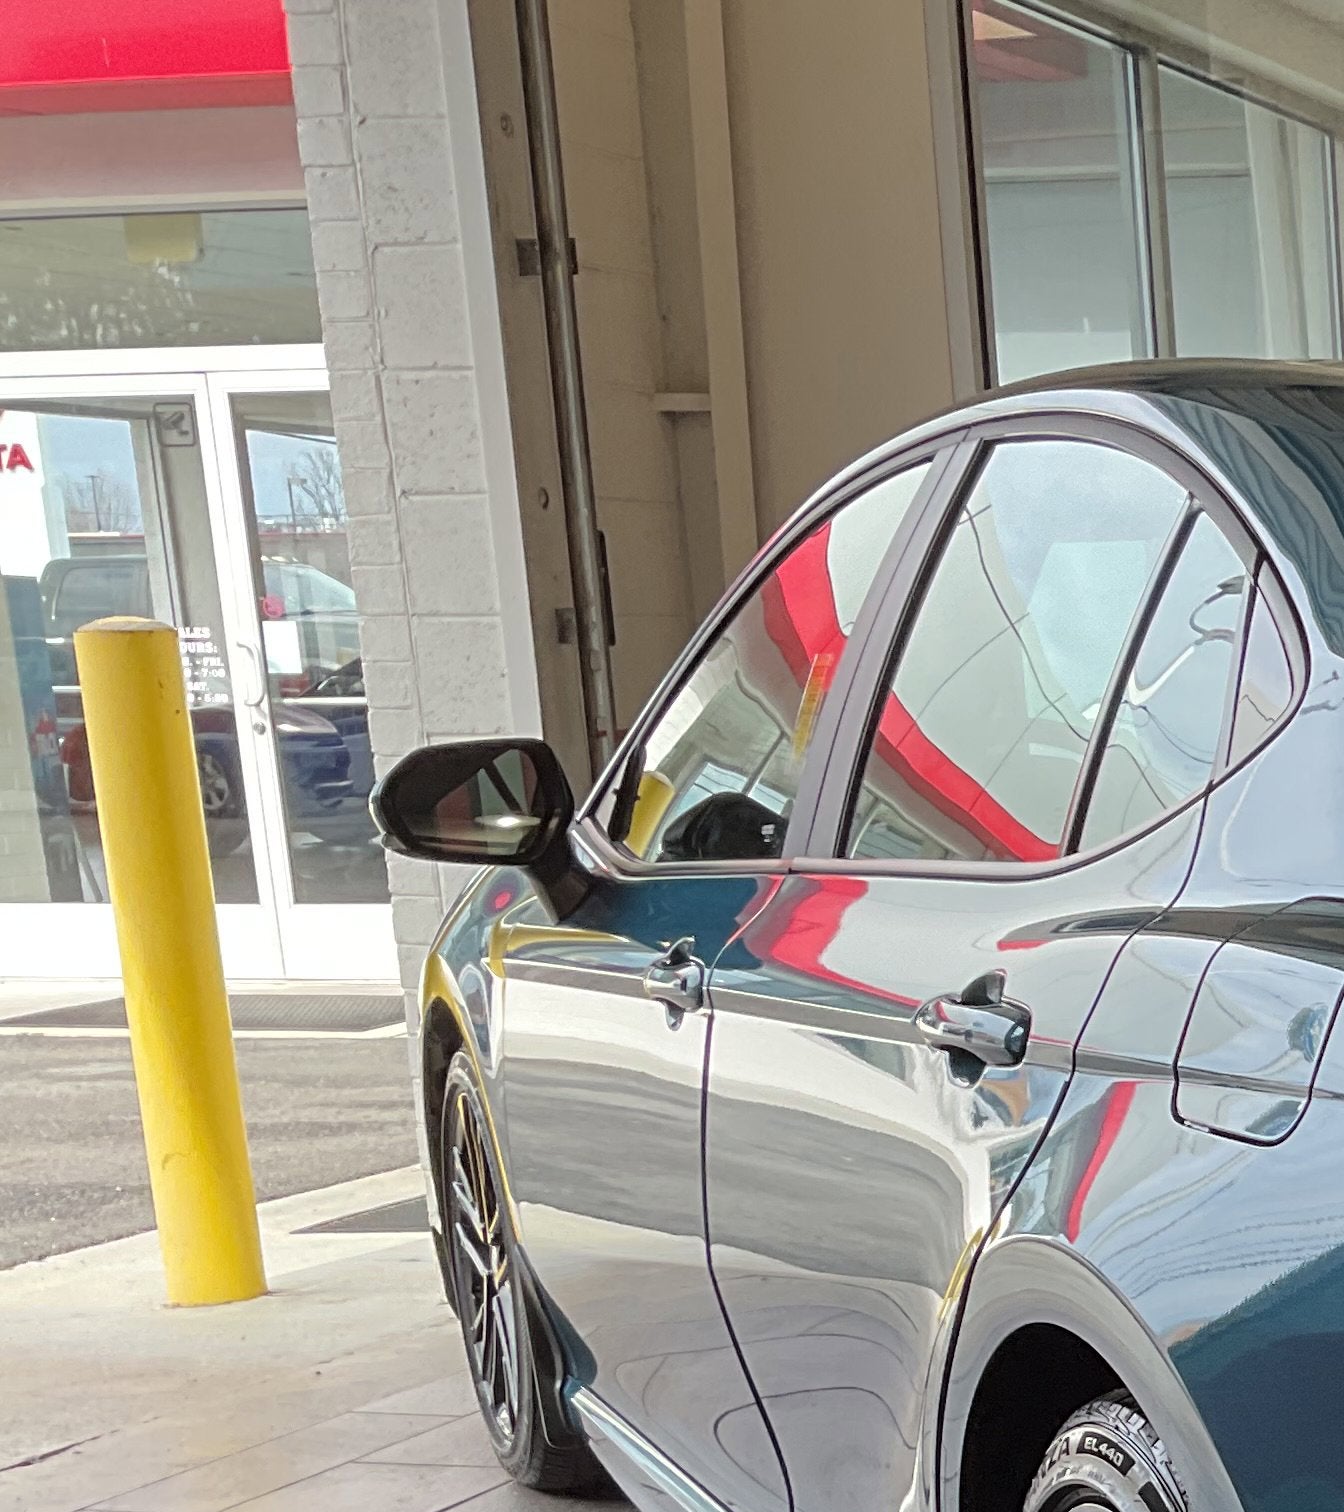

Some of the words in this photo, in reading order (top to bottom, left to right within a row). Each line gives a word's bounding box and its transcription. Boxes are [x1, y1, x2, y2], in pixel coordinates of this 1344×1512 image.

[177, 626, 211, 639] ALES
[179, 641, 218, 653] OURS:
[1083, 1435, 1125, 1468] EL440
